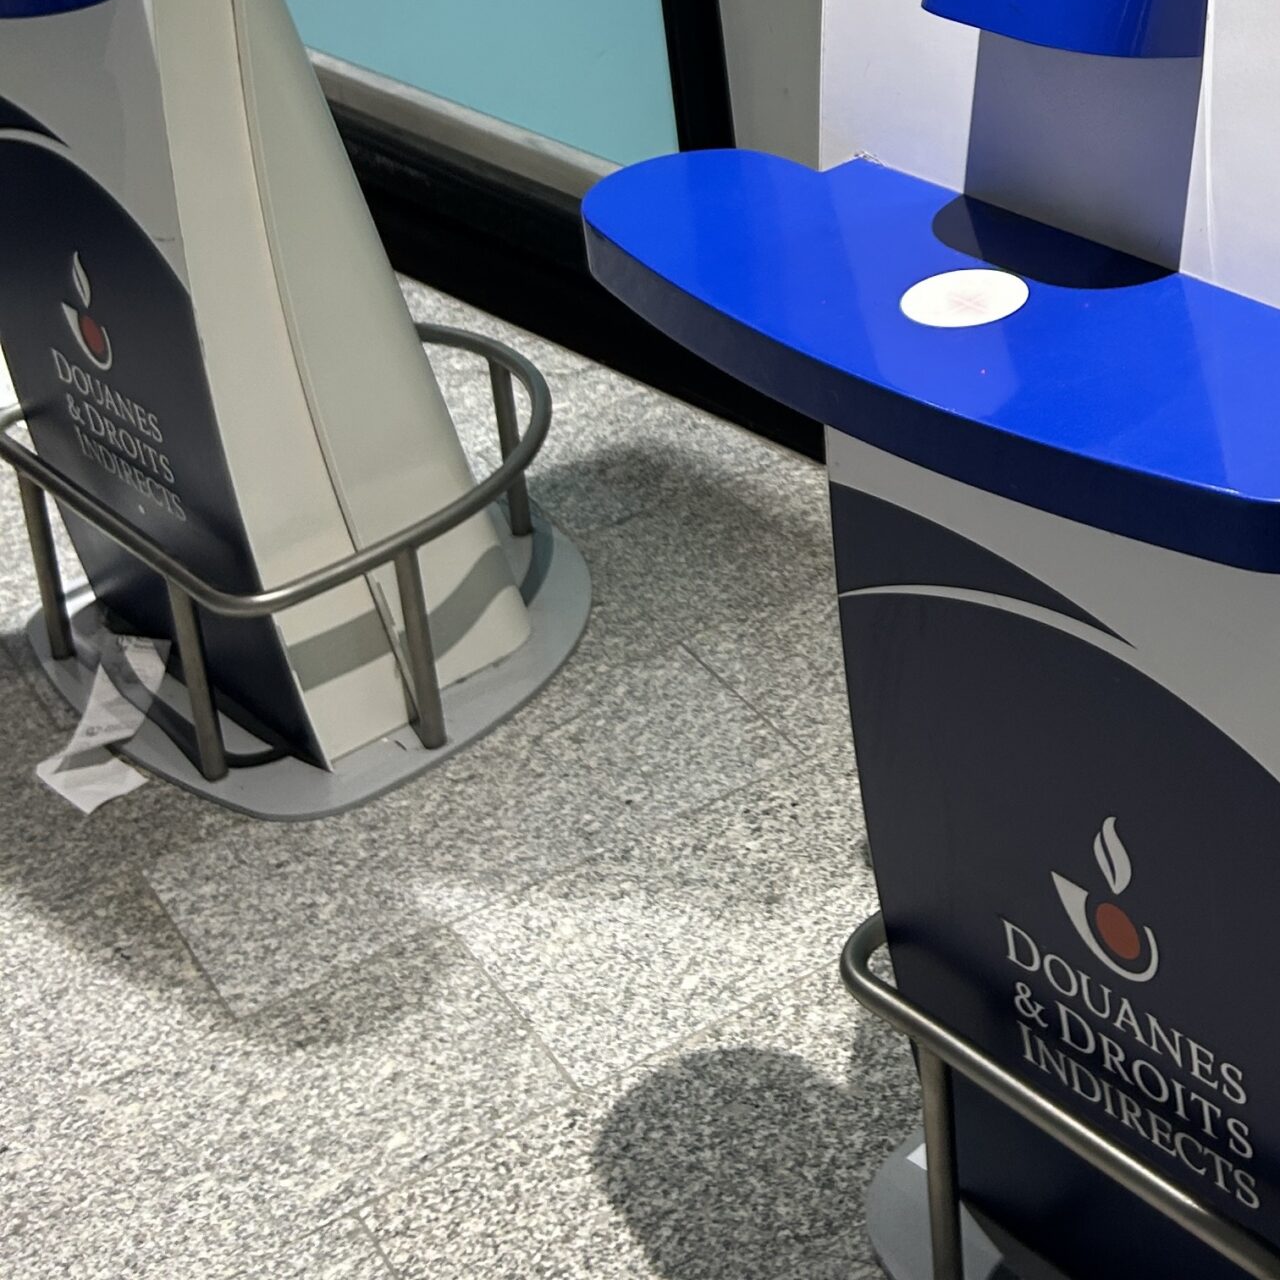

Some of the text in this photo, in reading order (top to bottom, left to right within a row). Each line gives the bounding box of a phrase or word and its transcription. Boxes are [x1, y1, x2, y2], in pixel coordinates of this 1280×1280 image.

[51, 347, 163, 443] DOUANES
[66, 392, 175, 484] & DROITS
[74, 424, 187, 522] INDIRECTS
[1001, 919, 1248, 1105] DOUANES
[1014, 981, 1254, 1159] & DROITS
[1017, 1020, 1260, 1209] INDIRECTS
